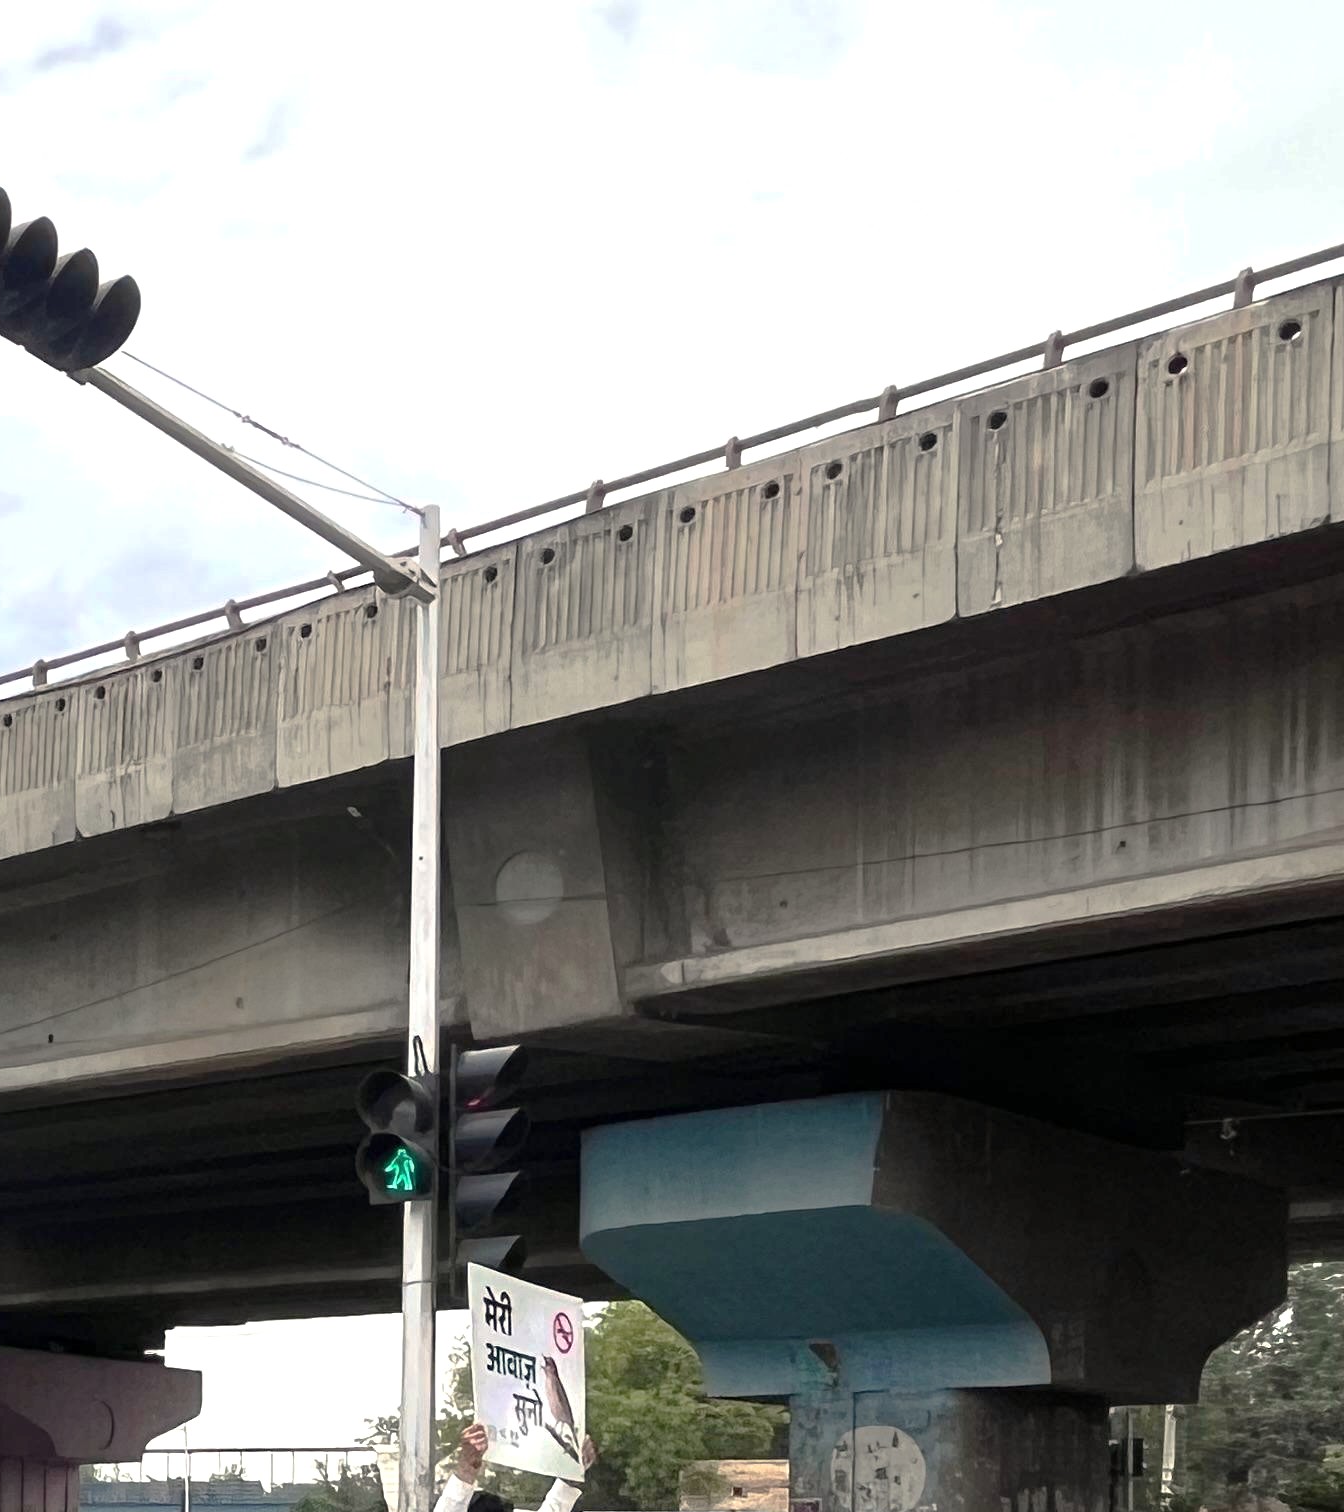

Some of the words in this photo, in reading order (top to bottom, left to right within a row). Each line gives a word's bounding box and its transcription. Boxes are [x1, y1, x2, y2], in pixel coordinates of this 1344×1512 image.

[483, 1286, 512, 1338] मेरी
[486, 1342, 537, 1386] आवाज़
[512, 1389, 543, 1436] सुनो
